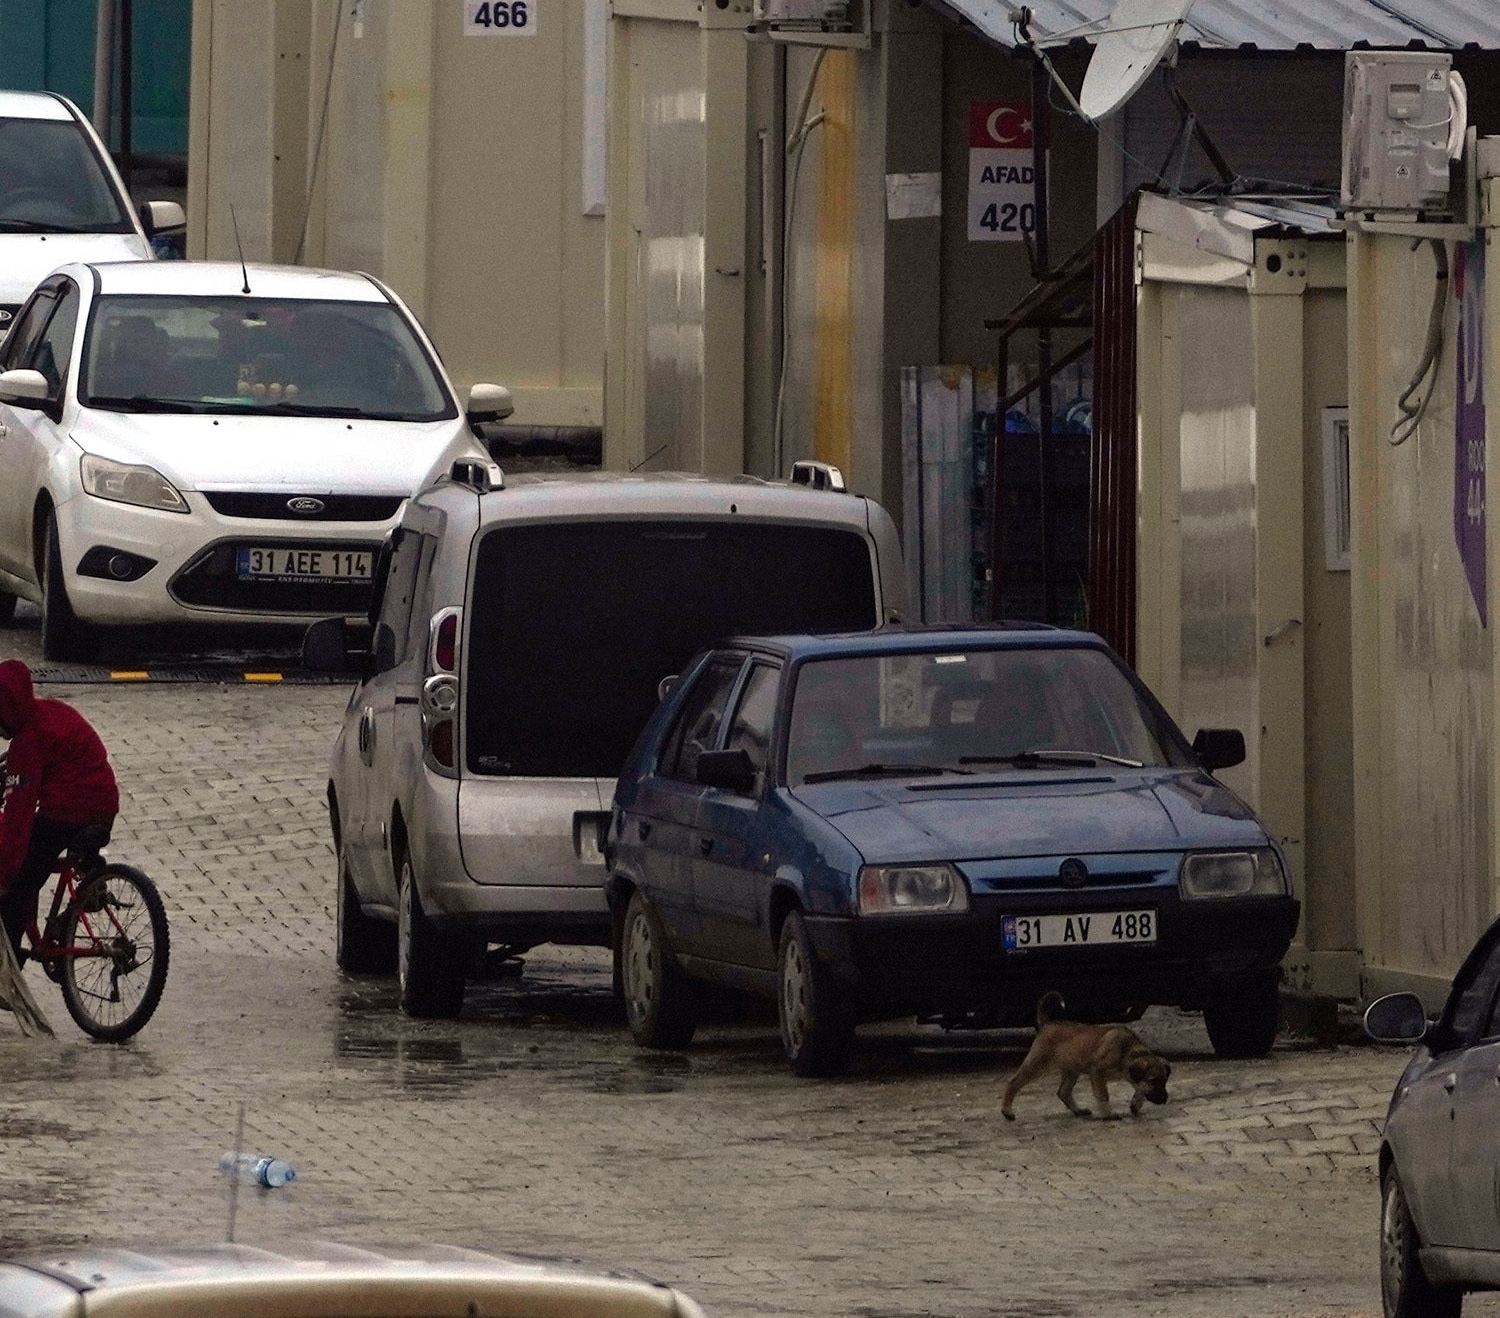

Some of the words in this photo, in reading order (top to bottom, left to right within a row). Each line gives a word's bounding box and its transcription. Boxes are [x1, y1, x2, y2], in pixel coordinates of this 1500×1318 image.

[474, 1, 528, 28] 466
[980, 165, 1035, 185] AFAD
[979, 202, 1036, 232] 420
[251, 550, 275, 573] 31
[284, 551, 322, 575] AEE
[332, 553, 367, 576] 114
[1018, 919, 1042, 945] 31
[1063, 916, 1091, 943] AV
[1111, 913, 1152, 941] 488
